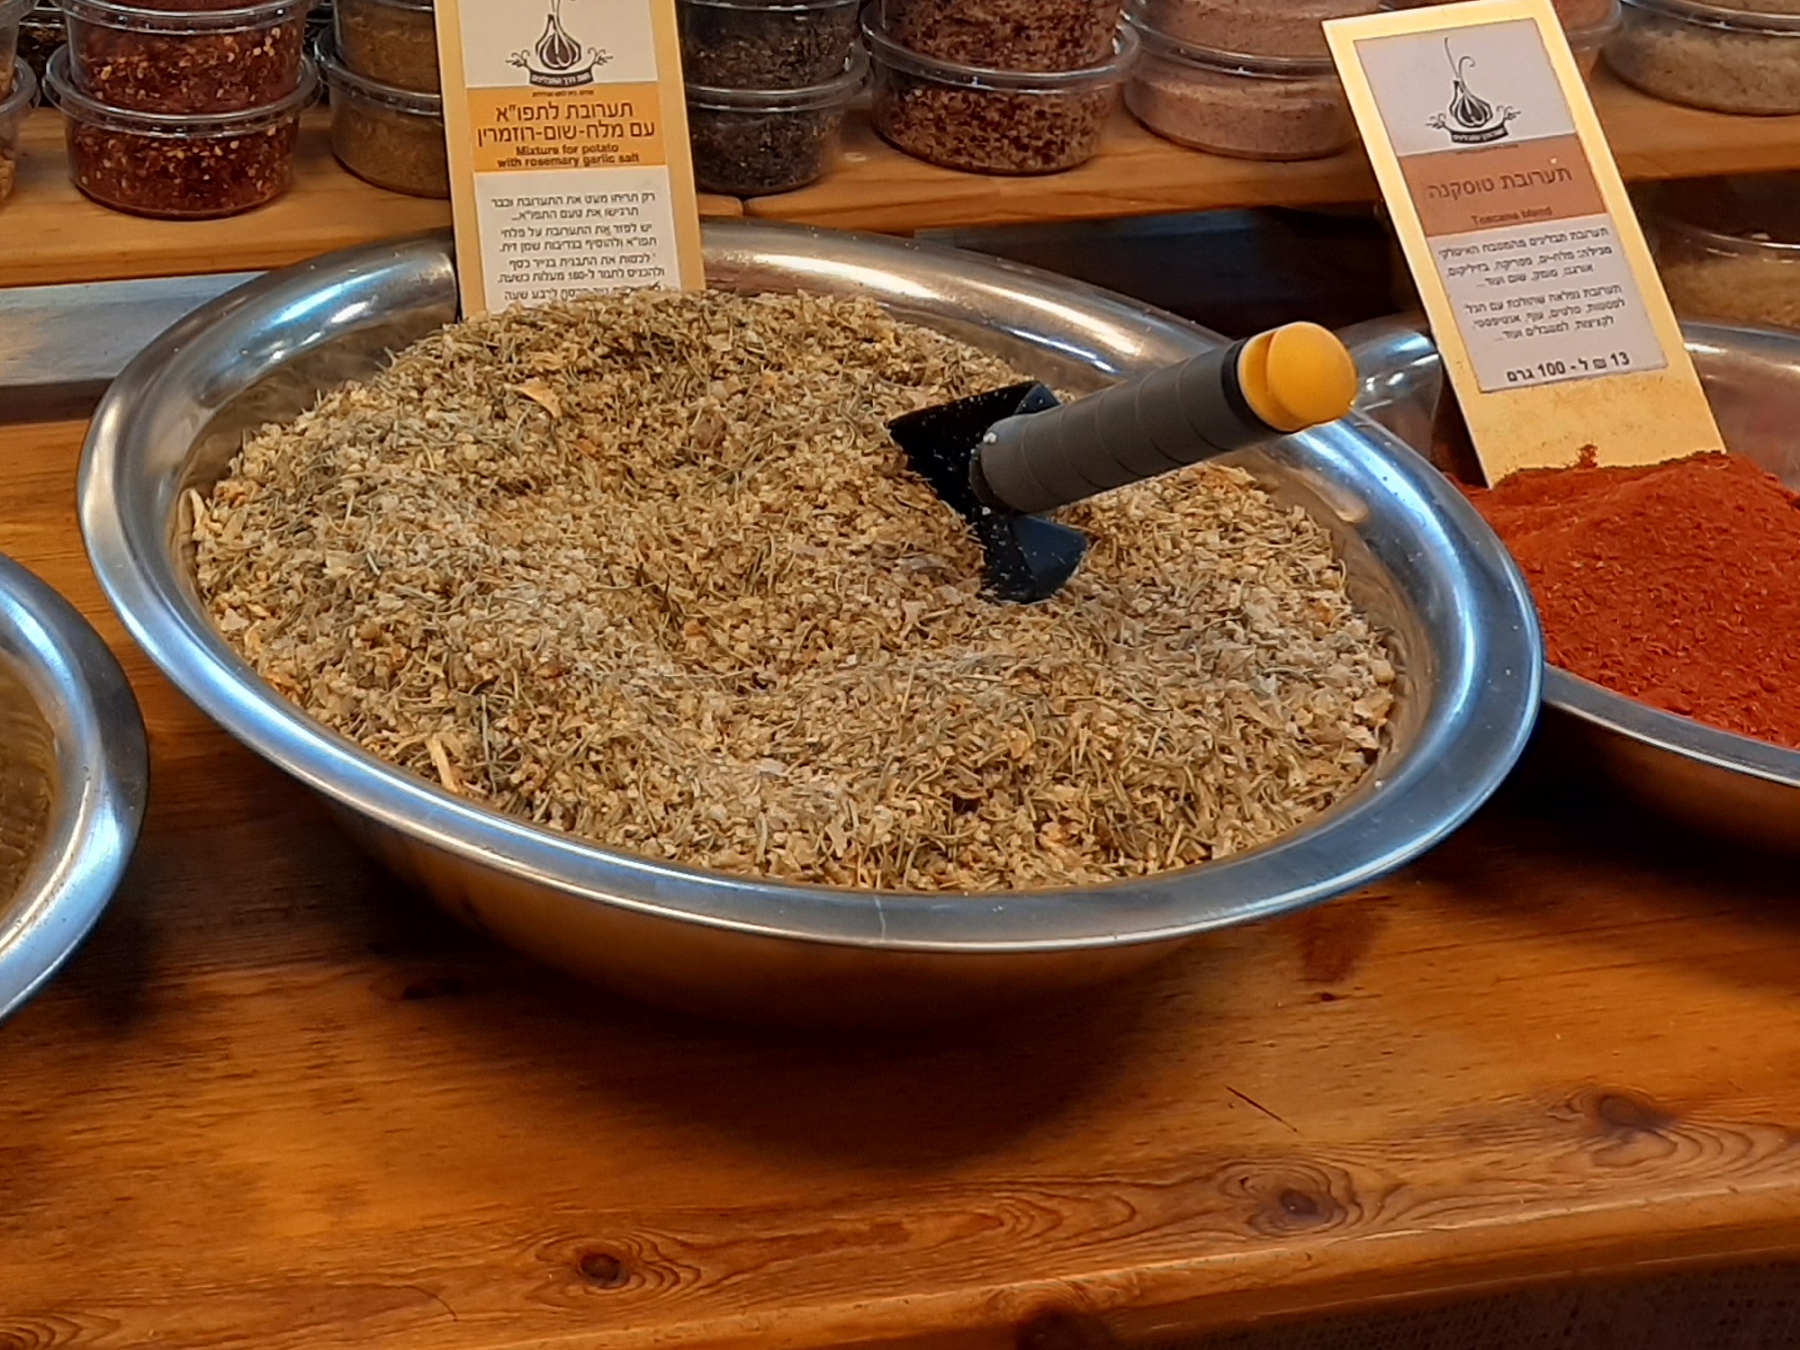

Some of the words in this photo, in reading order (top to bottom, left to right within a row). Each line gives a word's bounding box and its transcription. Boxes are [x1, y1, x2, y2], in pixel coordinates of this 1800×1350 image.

[495, 100, 559, 123] לתפו"א
[564, 101, 633, 120] תערובת
[477, 118, 624, 147] מלח-שום-רוזמרין
[628, 121, 655, 137] עם
[514, 144, 560, 156] Mixture
[560, 143, 579, 155] for
[580, 141, 619, 155] potato
[496, 157, 522, 168] with
[524, 156, 580, 167] rosemary
[582, 153, 616, 166] garlic
[617, 152, 639, 163] salt
[1498, 166, 1573, 190] תערובת
[1426, 177, 1495, 201] טוסקנה
[565, 195, 582, 205] את
[583, 193, 608, 204] מעט
[640, 191, 656, 204] רק
[526, 225, 542, 237] על
[593, 224, 612, 236] את
[639, 223, 652, 233] יש
[508, 258, 531, 271] כסף
[599, 255, 616, 266] את
[1576, 357, 1589, 371] ל
[1591, 357, 1607, 369] ₪
[1609, 350, 1630, 366] 13
[1505, 367, 1535, 382] גרם
[1536, 360, 1566, 377] 100
